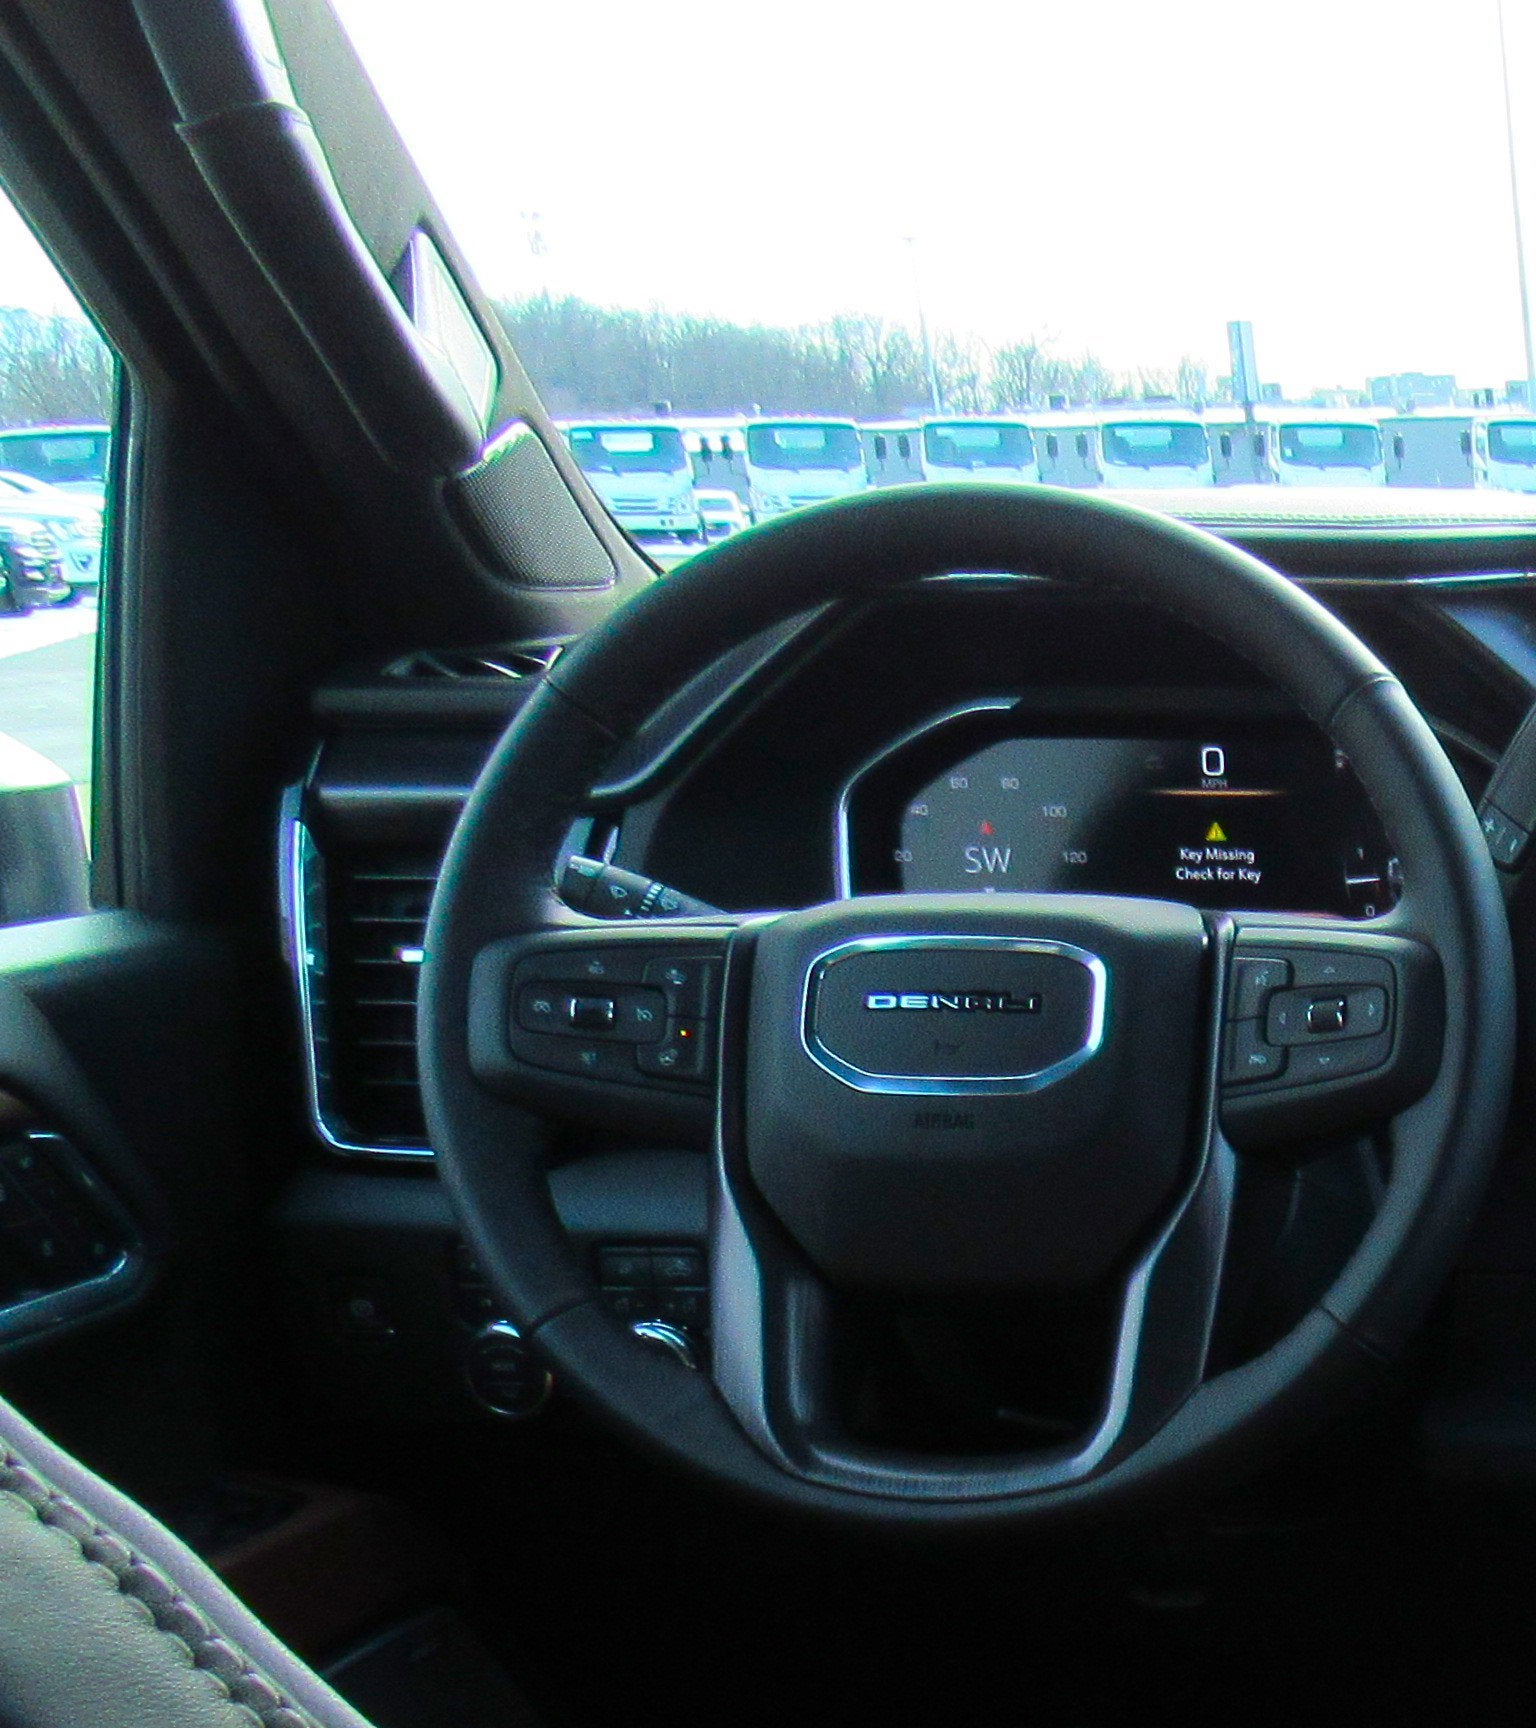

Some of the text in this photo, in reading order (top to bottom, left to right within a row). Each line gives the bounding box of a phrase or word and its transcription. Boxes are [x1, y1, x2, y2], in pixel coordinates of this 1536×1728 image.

[1200, 745, 1226, 778] 0
[1201, 778, 1229, 789] MPH
[1042, 805, 1068, 818] 100
[963, 846, 1013, 875] SW
[1062, 850, 1089, 864] 120
[1178, 847, 1256, 865] Key Missing
[1174, 867, 1262, 885] Check for Key
[866, 993, 1041, 1012] DENALI
